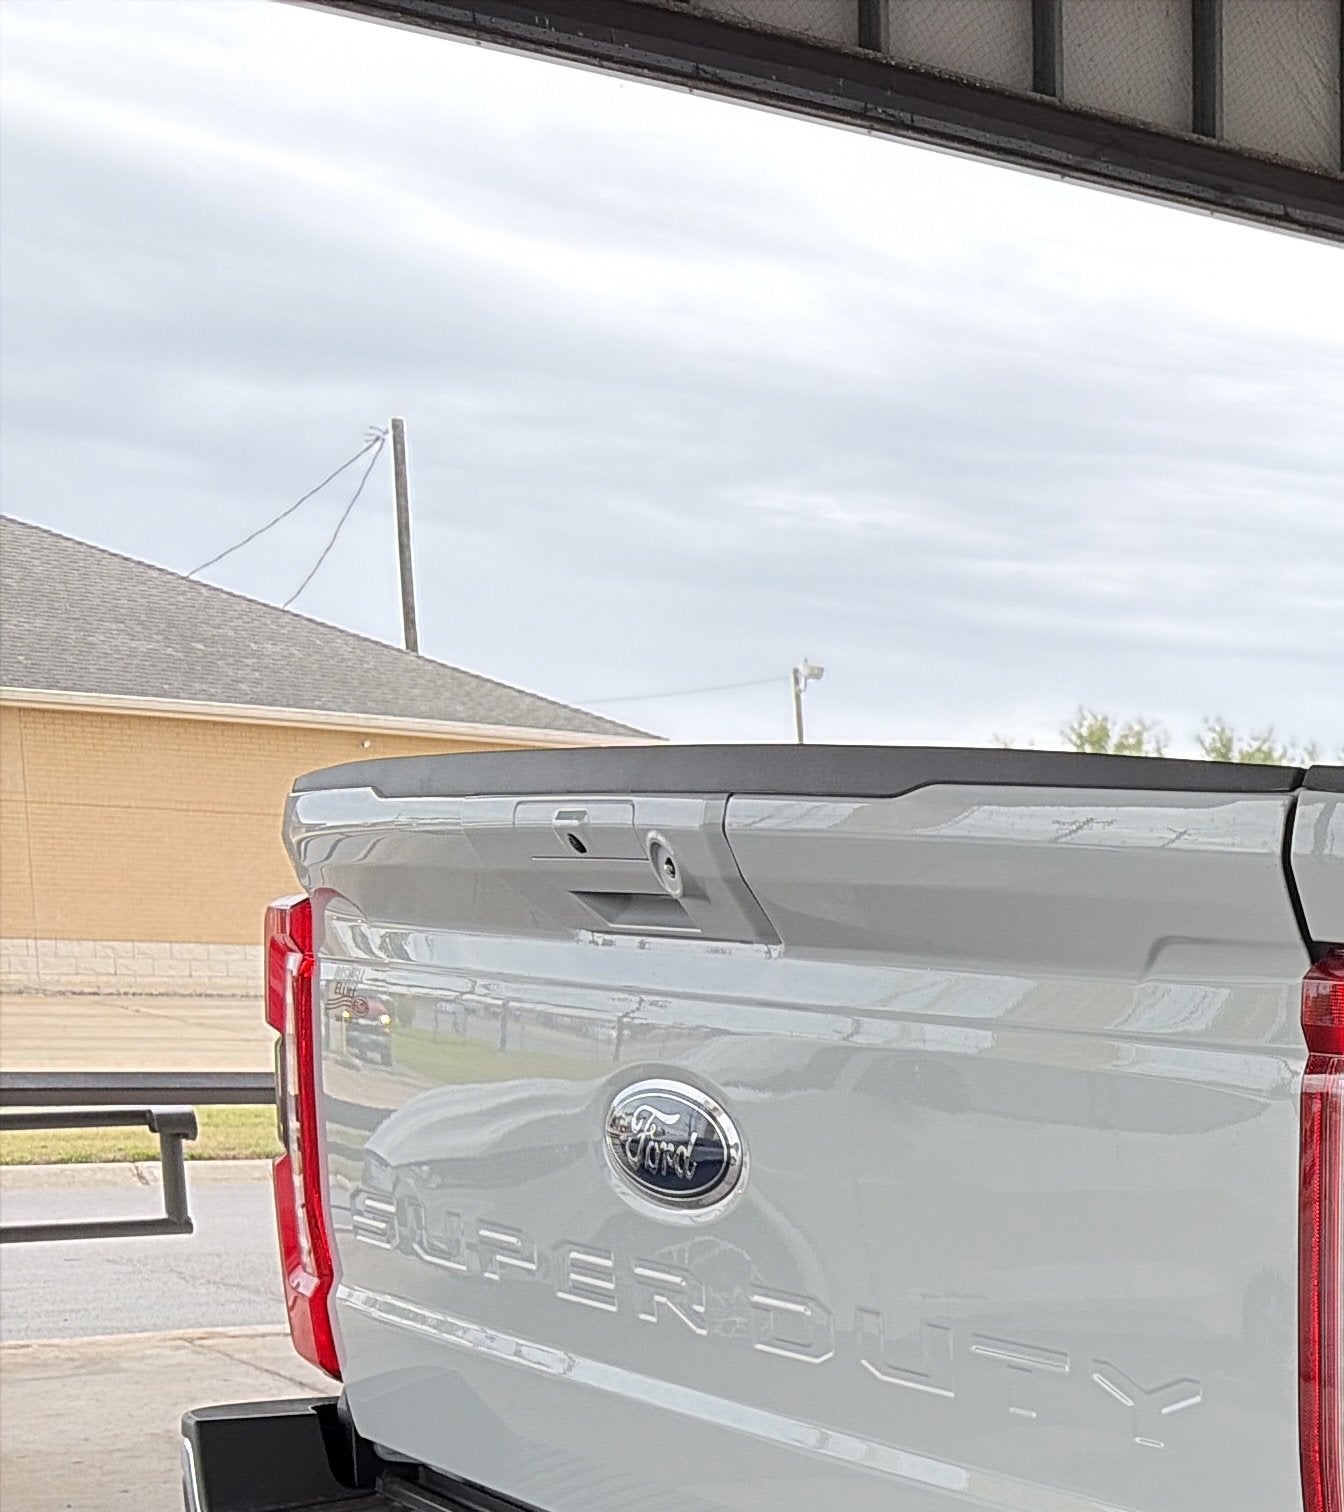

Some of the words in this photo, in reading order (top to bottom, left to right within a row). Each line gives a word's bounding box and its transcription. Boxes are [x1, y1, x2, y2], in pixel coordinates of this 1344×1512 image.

[626, 1104, 698, 1180] Ford
[350, 1185, 709, 1336] SUPER
[750, 1283, 1203, 1448] DUTY
